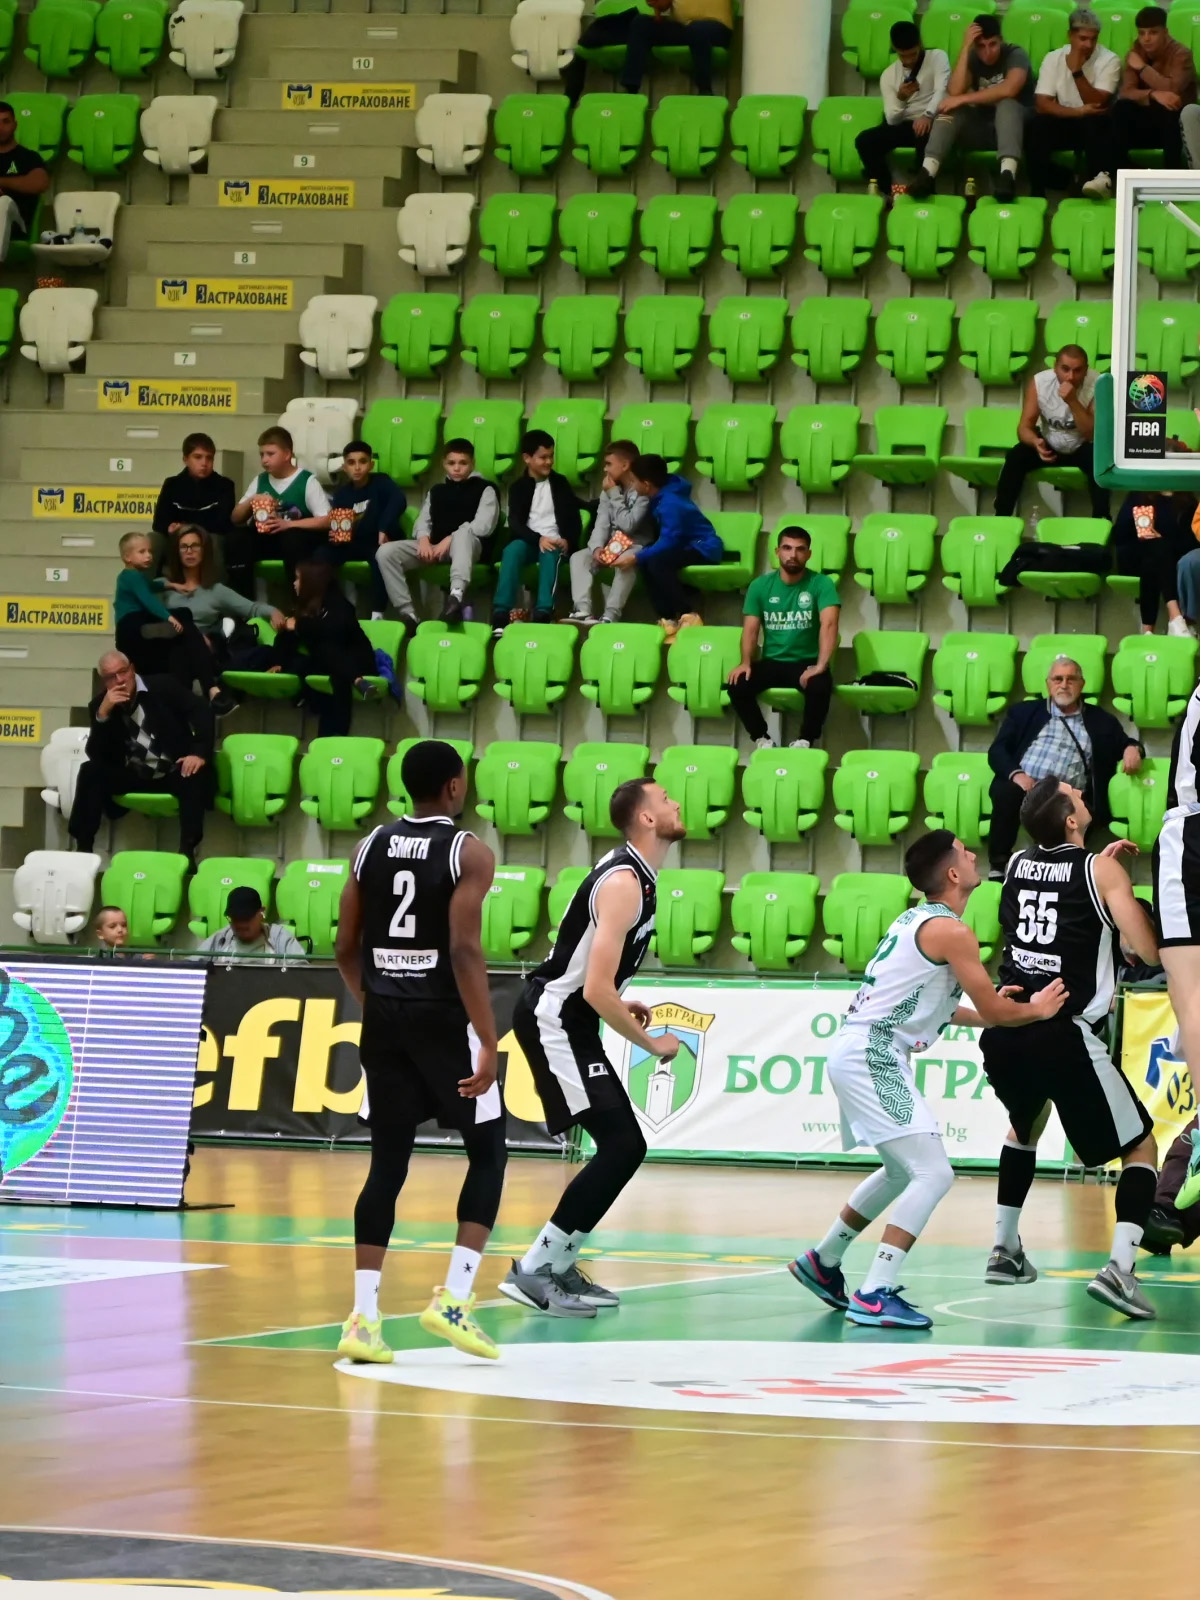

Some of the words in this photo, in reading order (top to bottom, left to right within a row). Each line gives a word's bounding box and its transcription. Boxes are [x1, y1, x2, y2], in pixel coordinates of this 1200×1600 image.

[356, 58, 371, 69] 10
[322, 88, 411, 108] ЗАСТРАХОВАНЕ
[300, 155, 308, 166] 9
[258, 185, 349, 206] ЗАСТРАХОВАНЕ
[241, 253, 249, 263] 8
[196, 285, 288, 305] ЗАСТРАХОВАНЕ
[181, 353, 188, 364] 7
[139, 386, 232, 408] ЗАСТРАХОВАНЕ
[1131, 422, 1160, 437] FIBA
[116, 459, 124, 470] 6
[53, 570, 60, 580] 5
[7, 602, 104, 626] ЗАСТРАХОВАНЕ
[763, 610, 812, 622] BALKAN
[387, 834, 431, 860] SMITH
[1014, 858, 1073, 882] KRESTININ
[388, 869, 416, 938] 2
[1015, 889, 1059, 945] 55
[878, 1251, 893, 1261] 23
